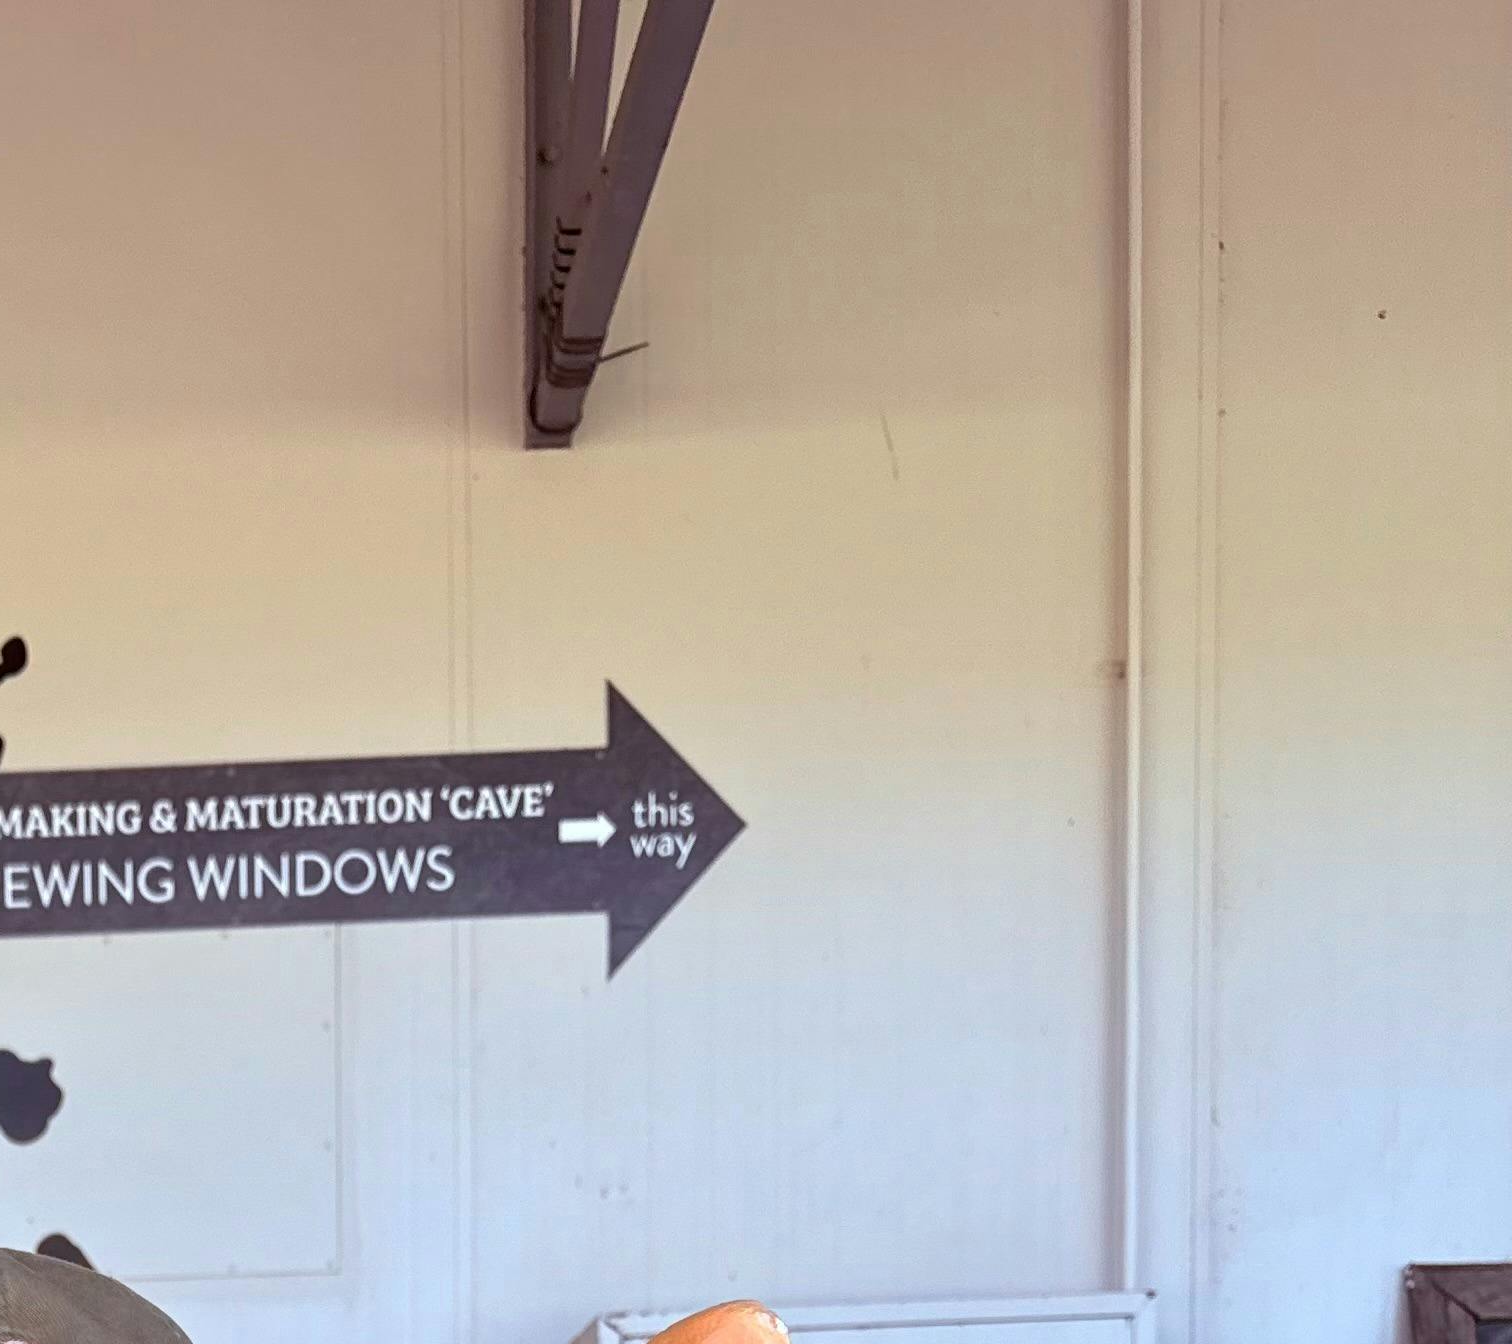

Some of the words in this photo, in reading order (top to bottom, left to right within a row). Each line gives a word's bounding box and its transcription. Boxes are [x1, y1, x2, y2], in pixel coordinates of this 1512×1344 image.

[148, 798, 178, 834] &
[184, 787, 432, 831] MATURATION
[631, 791, 695, 829] this
[630, 829, 697, 869] way
[187, 845, 457, 901] WINDOWS
